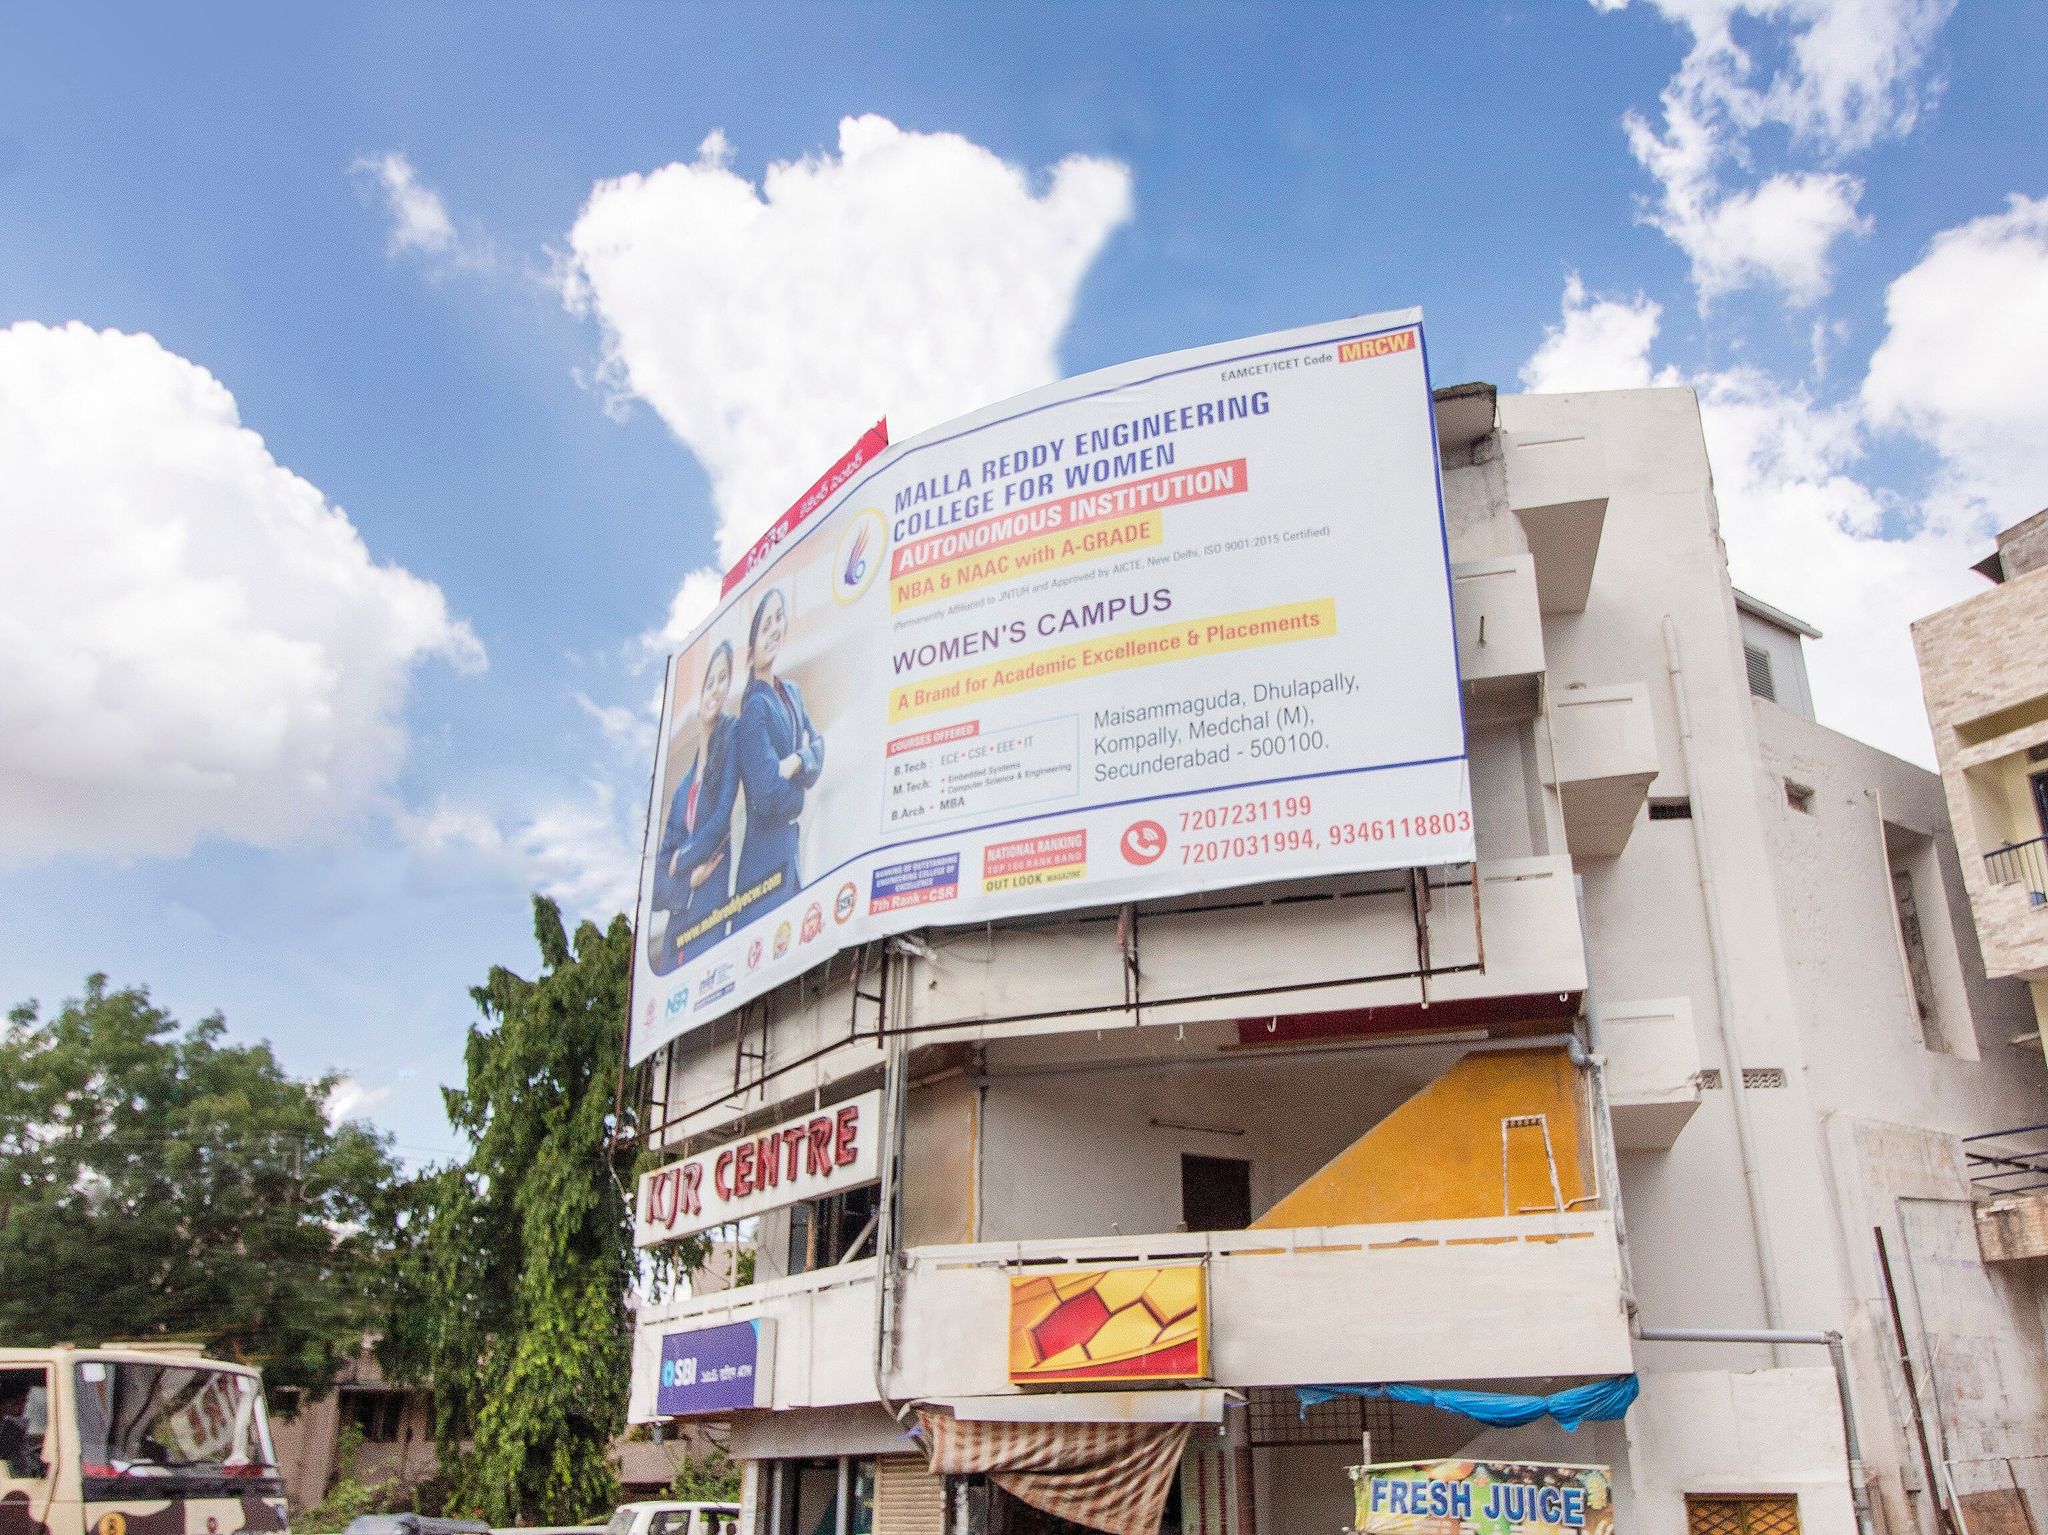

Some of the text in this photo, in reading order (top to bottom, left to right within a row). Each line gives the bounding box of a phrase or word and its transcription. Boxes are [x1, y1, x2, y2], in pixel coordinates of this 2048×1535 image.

[1221, 335, 1410, 382] EAMCET/ICET Code MRCW
[895, 468, 971, 514] MALLA
[983, 439, 1064, 484] REDDY
[1076, 391, 1270, 456] ENGINEERING
[894, 442, 1174, 542] COLLEGE FOR WOMEN
[899, 466, 1234, 571] AUTONOMOUS INSTITUTION
[898, 521, 1151, 602] NBA & NAAC with A-GRADE
[947, 599, 985, 615] Affiliated
[986, 597, 996, 606] to
[998, 585, 1030, 602] JNTUH
[1031, 580, 1049, 593] and
[1051, 570, 1096, 590] Approved
[1097, 567, 1110, 580] by
[1146, 555, 1170, 567] New
[1204, 544, 1222, 556] ISO
[1282, 526, 1331, 543] Certified)
[893, 588, 1173, 675] WOMEN'S CAMPUS
[898, 612, 1321, 711] A Brand for Academic Excellence & Placements
[1094, 673, 1360, 729] Maisammaguda, Dhulapally,
[968, 746, 987, 760] CSE
[996, 740, 1015, 753] EEE
[1023, 736, 1034, 748] IT
[1094, 705, 1315, 755] Kompally, Medchal (M),
[1094, 744, 1230, 782] Secunderabad
[1250, 731, 1329, 758] 500100.
[939, 797, 965, 810] MBA
[1179, 795, 1312, 832] 7207231199
[1180, 810, 1471, 865] 7207031994, 9346118803
[892, 892, 920, 909] Rank
[929, 886, 955, 901] CSR
[986, 878, 1010, 891] OUT
[1013, 873, 1042, 888] LOOK
[646, 1105, 860, 1230] KJR CENTRE
[674, 1357, 698, 1387] SBI
[1371, 1478, 1472, 1518] FRESH
[1483, 1482, 1586, 1526] JUICE
